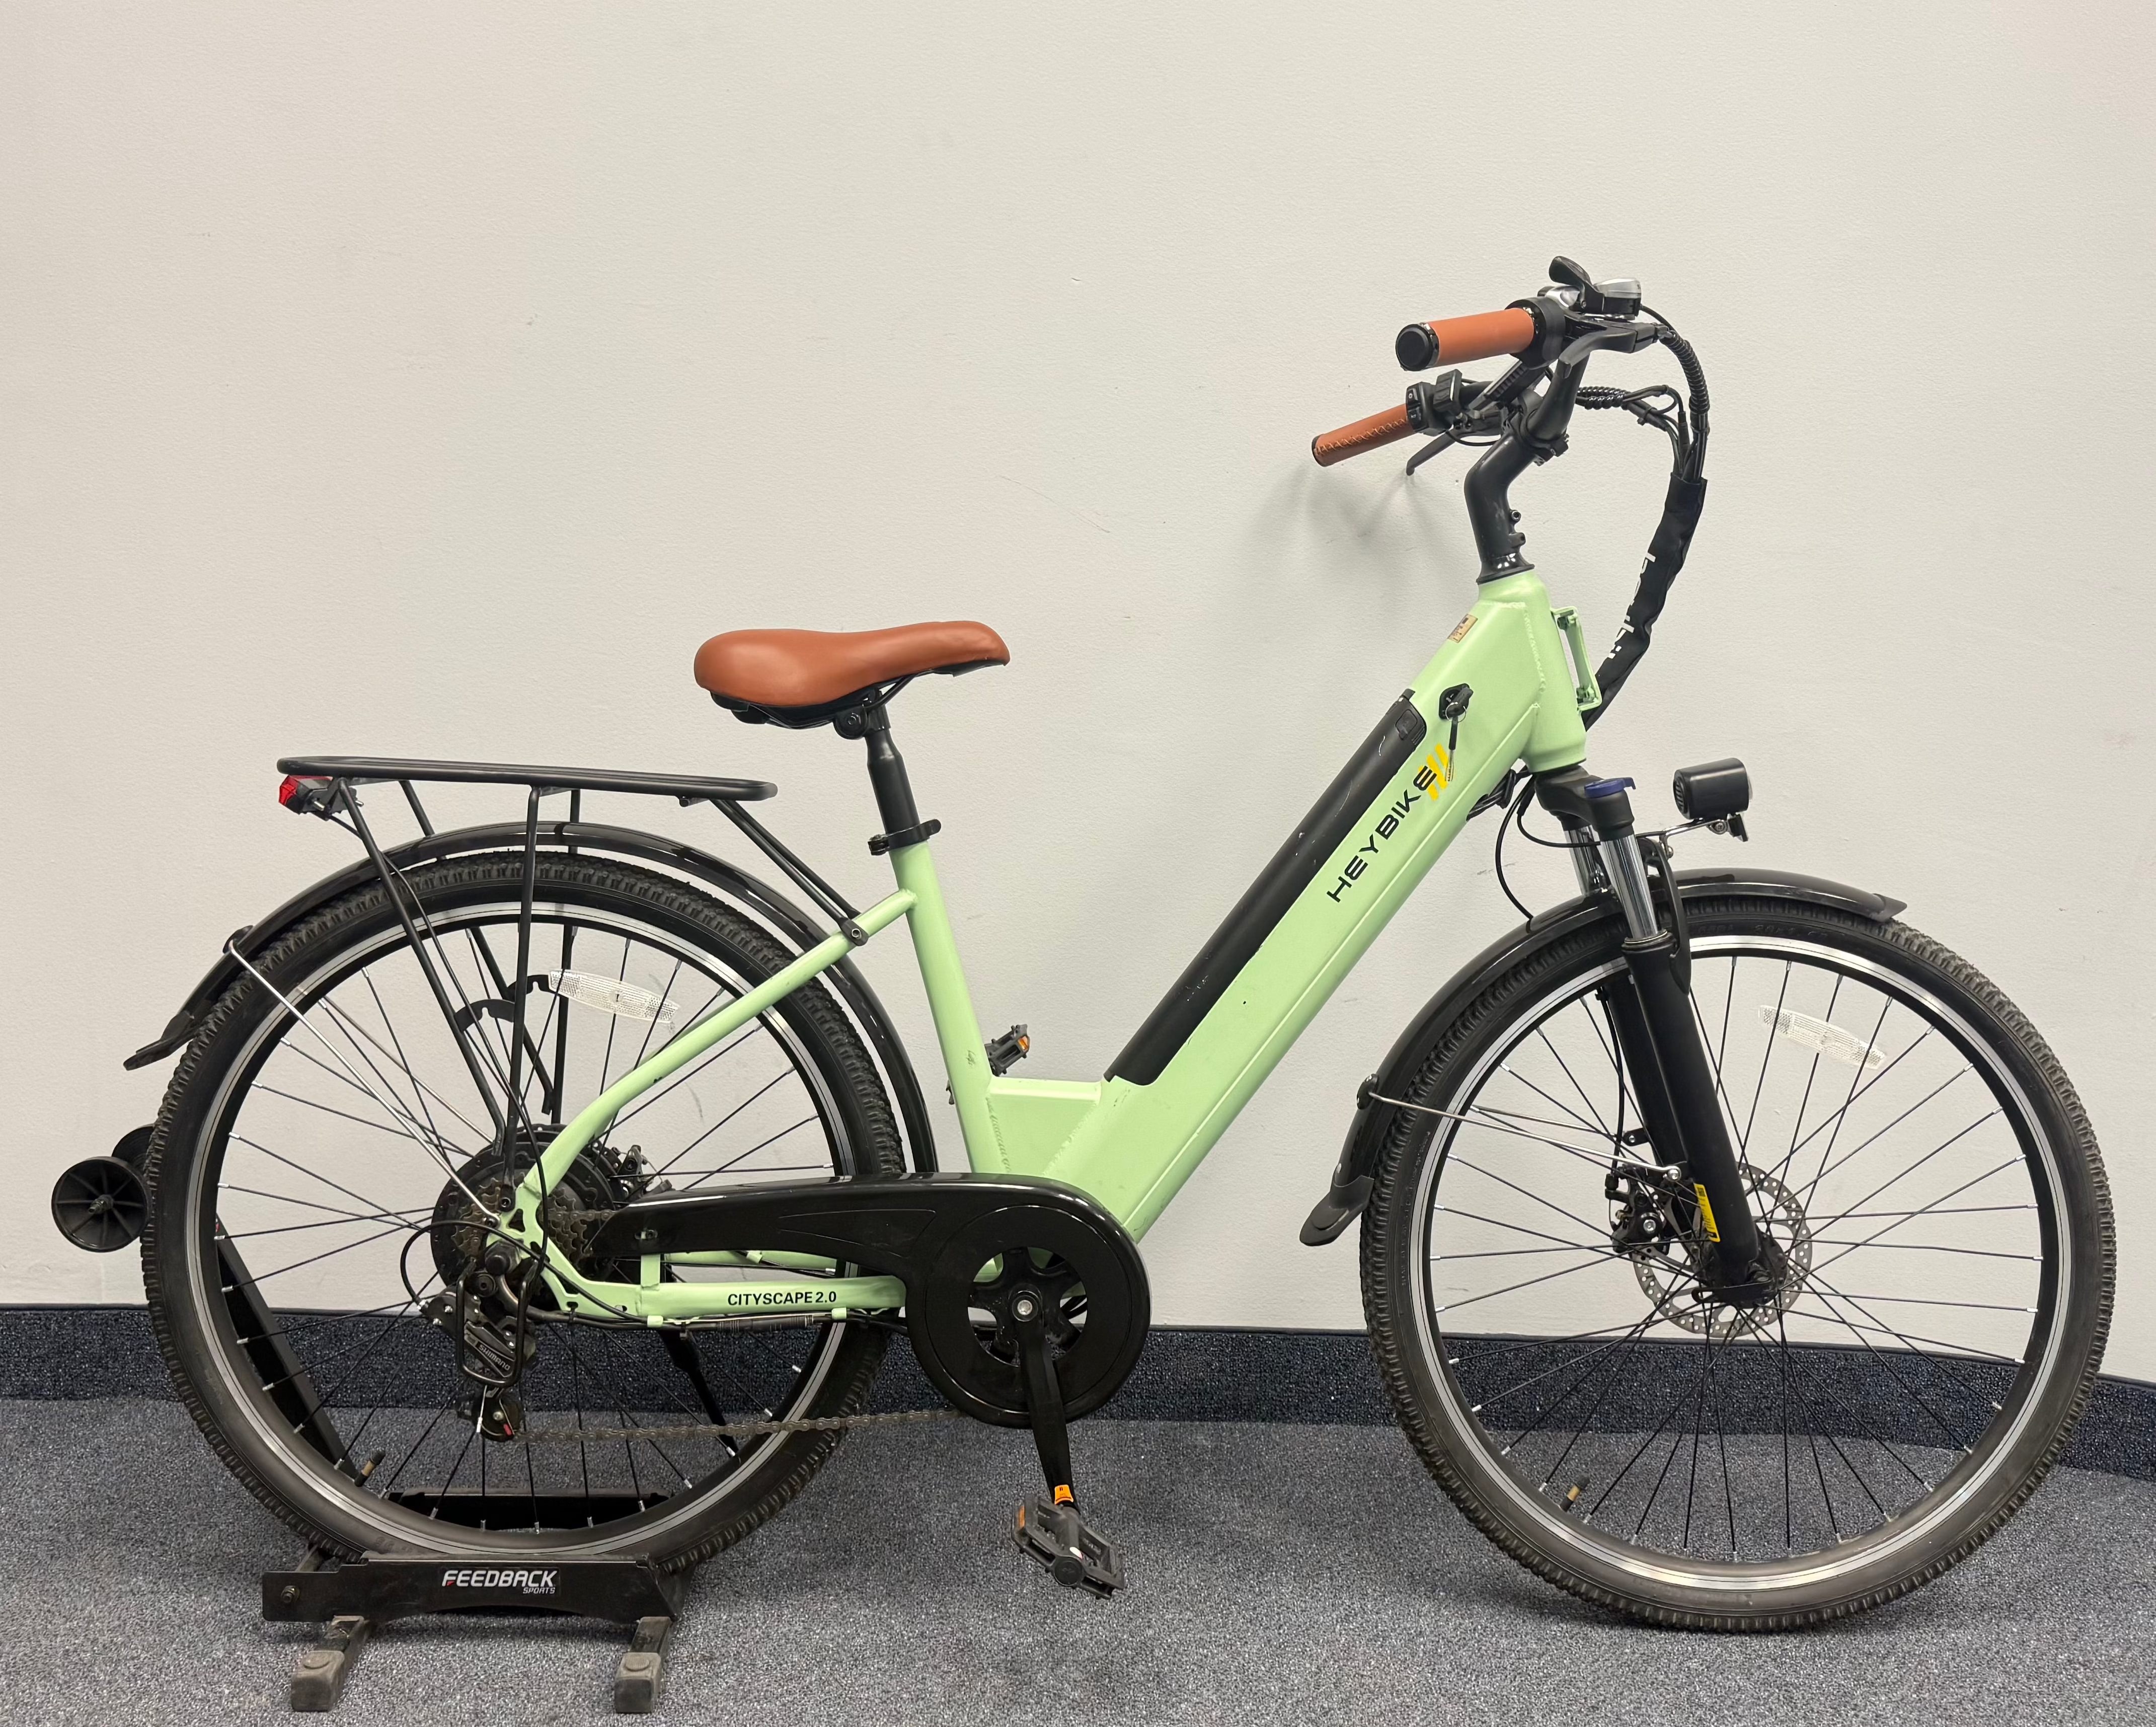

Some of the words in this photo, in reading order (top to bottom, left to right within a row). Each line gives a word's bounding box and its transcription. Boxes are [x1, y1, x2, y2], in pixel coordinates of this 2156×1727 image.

[1326, 765, 1438, 903] HEYBIKE
[728, 1292, 813, 1306] CITYSCAPE
[815, 1291, 836, 1303] 2.0
[479, 1344, 511, 1371] SHIMANO
[442, 1570, 557, 1587] FEEDBACK
